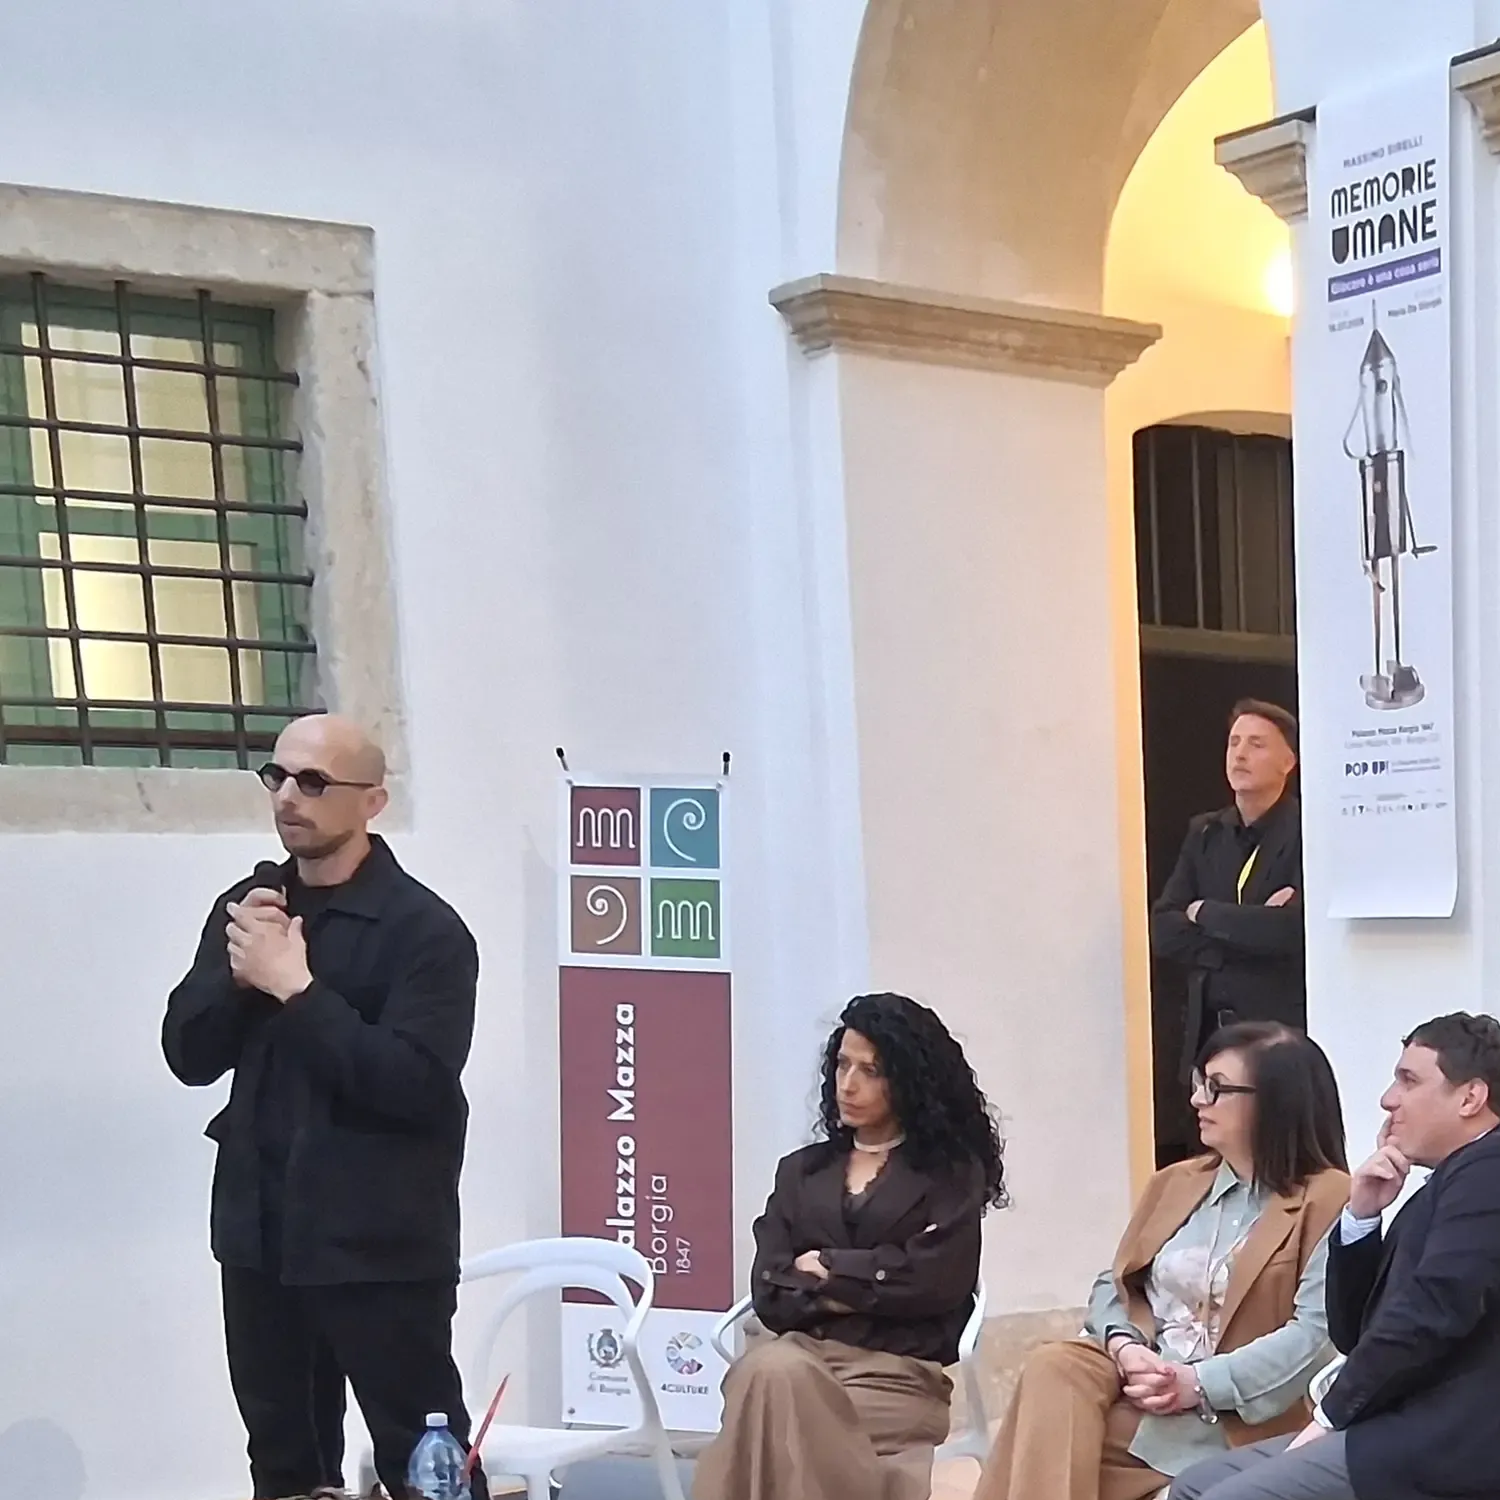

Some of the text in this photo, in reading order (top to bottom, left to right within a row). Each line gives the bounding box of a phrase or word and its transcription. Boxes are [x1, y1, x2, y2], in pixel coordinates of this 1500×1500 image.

[1331, 158, 1437, 219] MEMORIE
[1331, 198, 1438, 265] UMANE
[1345, 762, 1369, 777] POP
[606, 1003, 636, 1249] alazzo Mazza
[644, 1174, 674, 1275] Borgia
[675, 1236, 692, 1274] 1847
[660, 1383, 709, 1395] 4CULTURE
